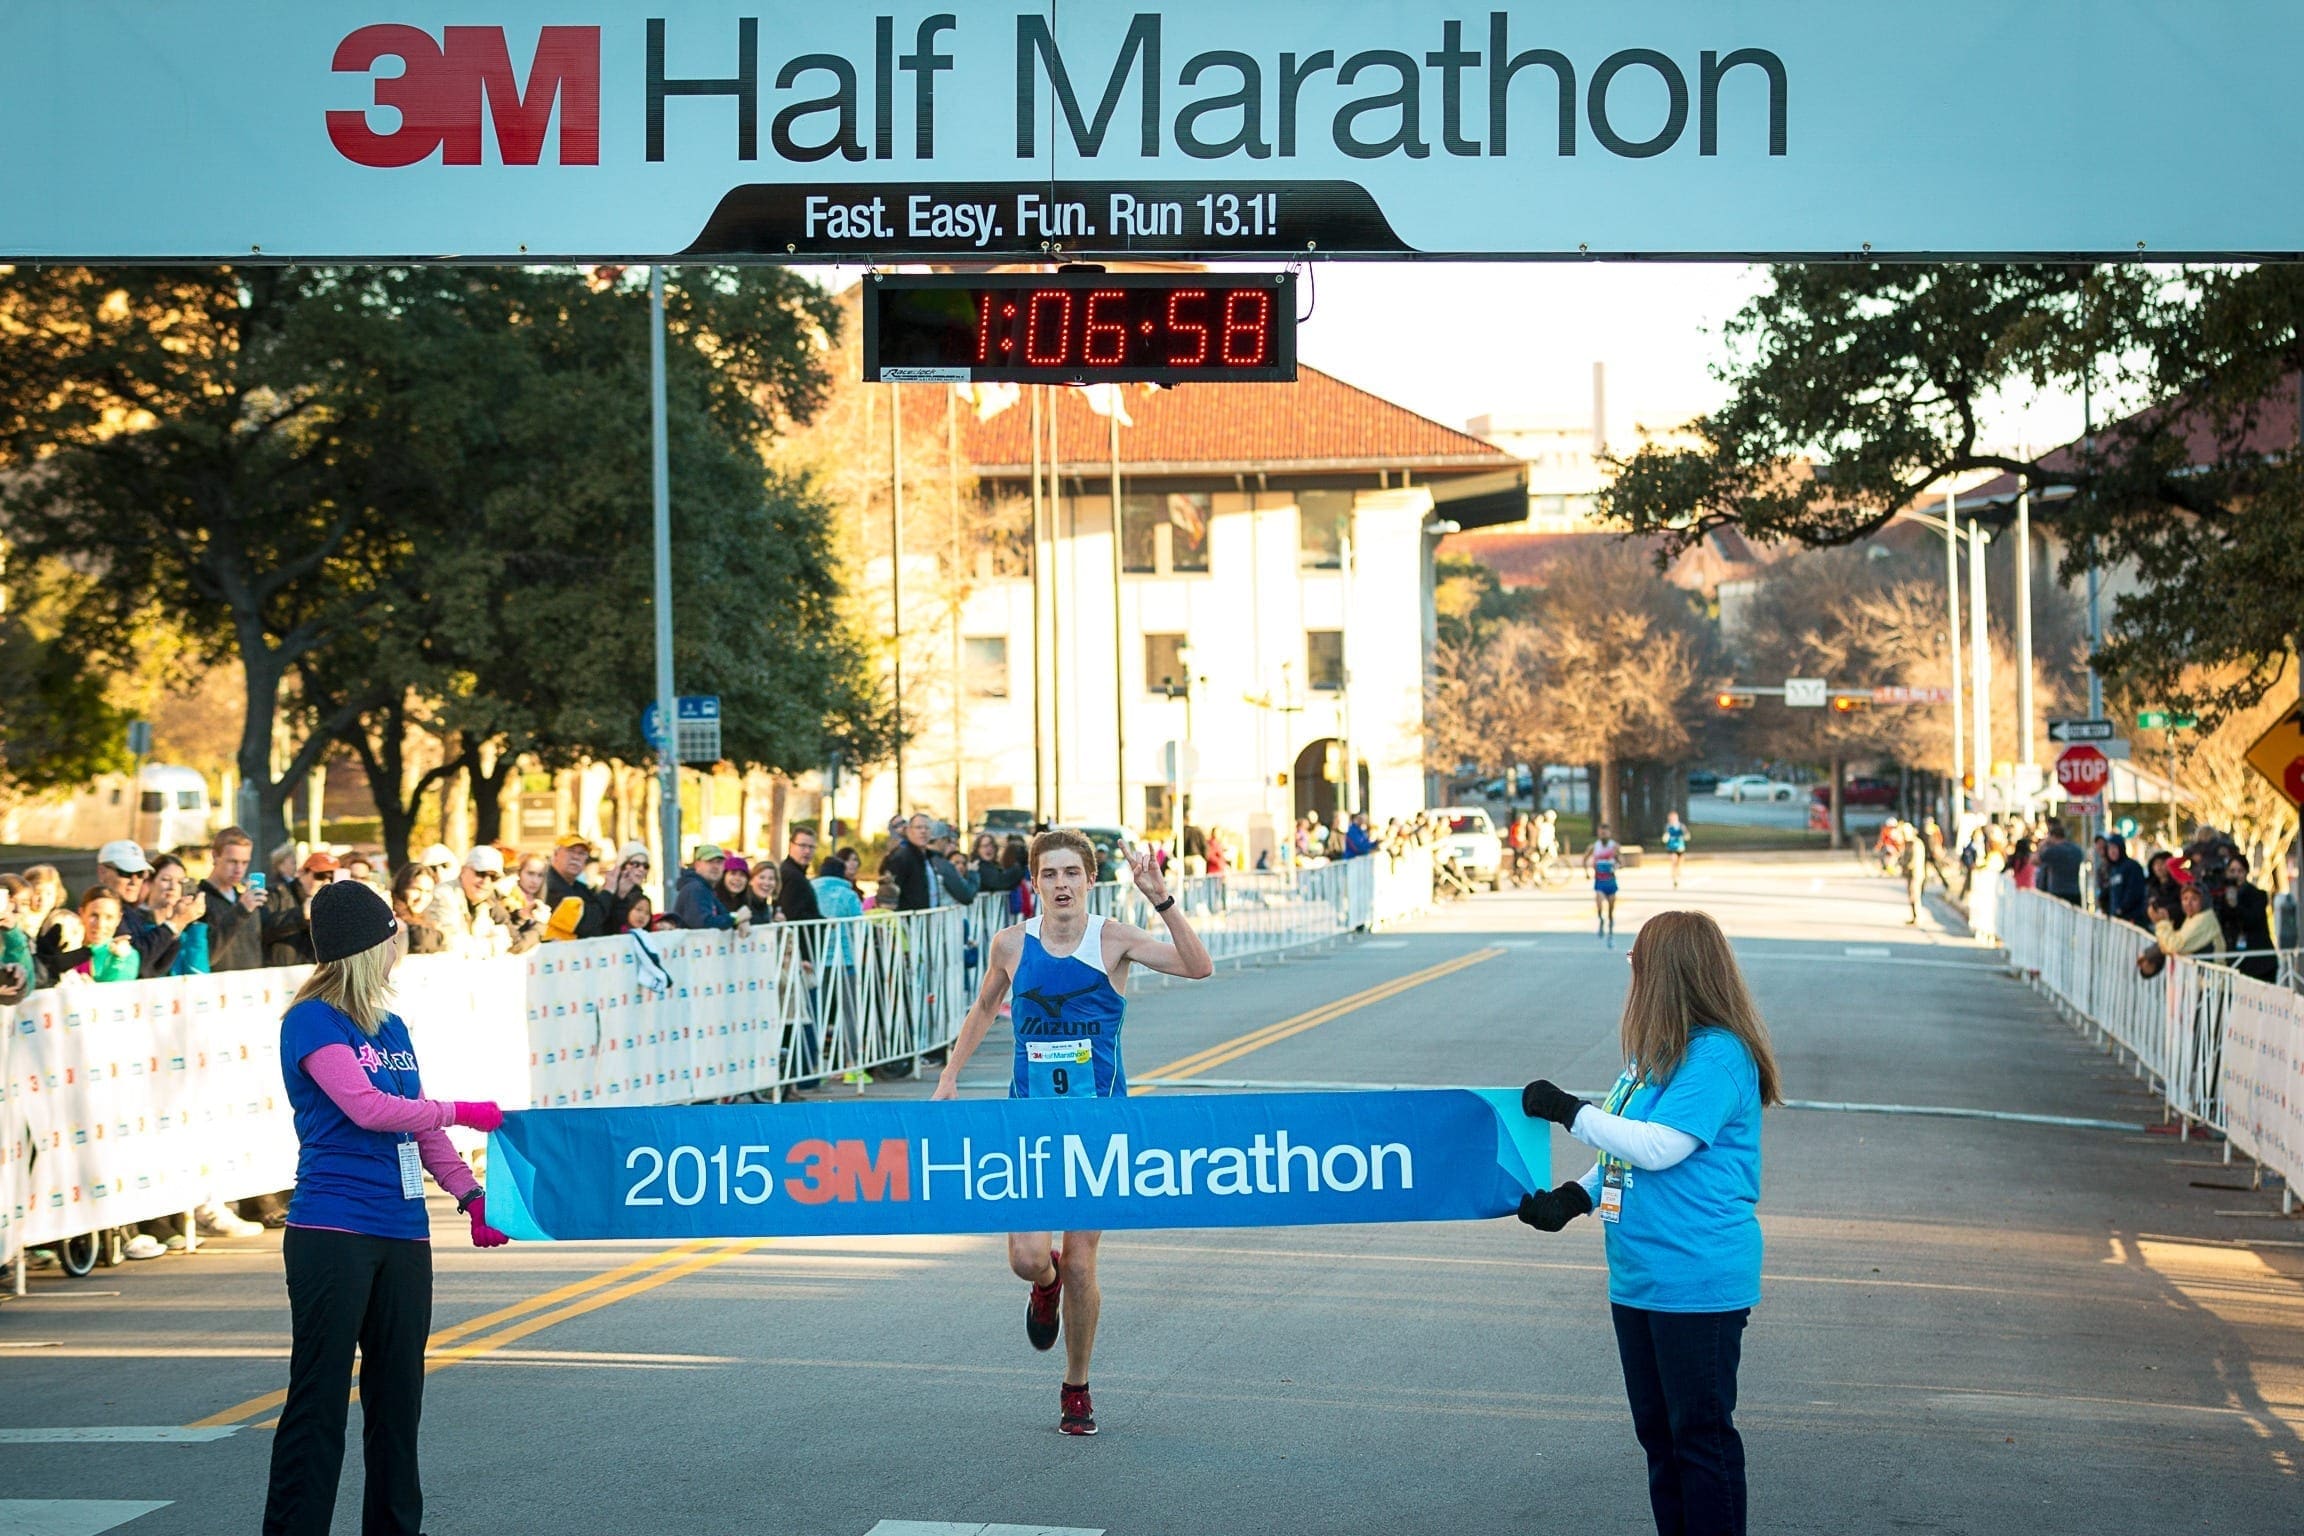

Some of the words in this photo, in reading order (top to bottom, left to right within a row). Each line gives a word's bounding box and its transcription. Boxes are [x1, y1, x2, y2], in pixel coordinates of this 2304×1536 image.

[325, 23, 601, 168] 3M
[645, 14, 957, 163] Half
[1015, 11, 1788, 160] Marathon
[805, 195, 894, 238] Fast.
[908, 195, 1003, 247] Easy.
[1017, 193, 1096, 237] Fun.
[1109, 193, 1183, 236] Run
[1196, 192, 1278, 236] 13.1!
[2058, 758, 2108, 784] STOP
[1052, 1067, 1070, 1096] 9
[624, 1144, 773, 1207] 2015
[784, 1137, 910, 1205] 3M
[920, 1134, 1053, 1202] Half
[1063, 1128, 1415, 1199] Marathon
